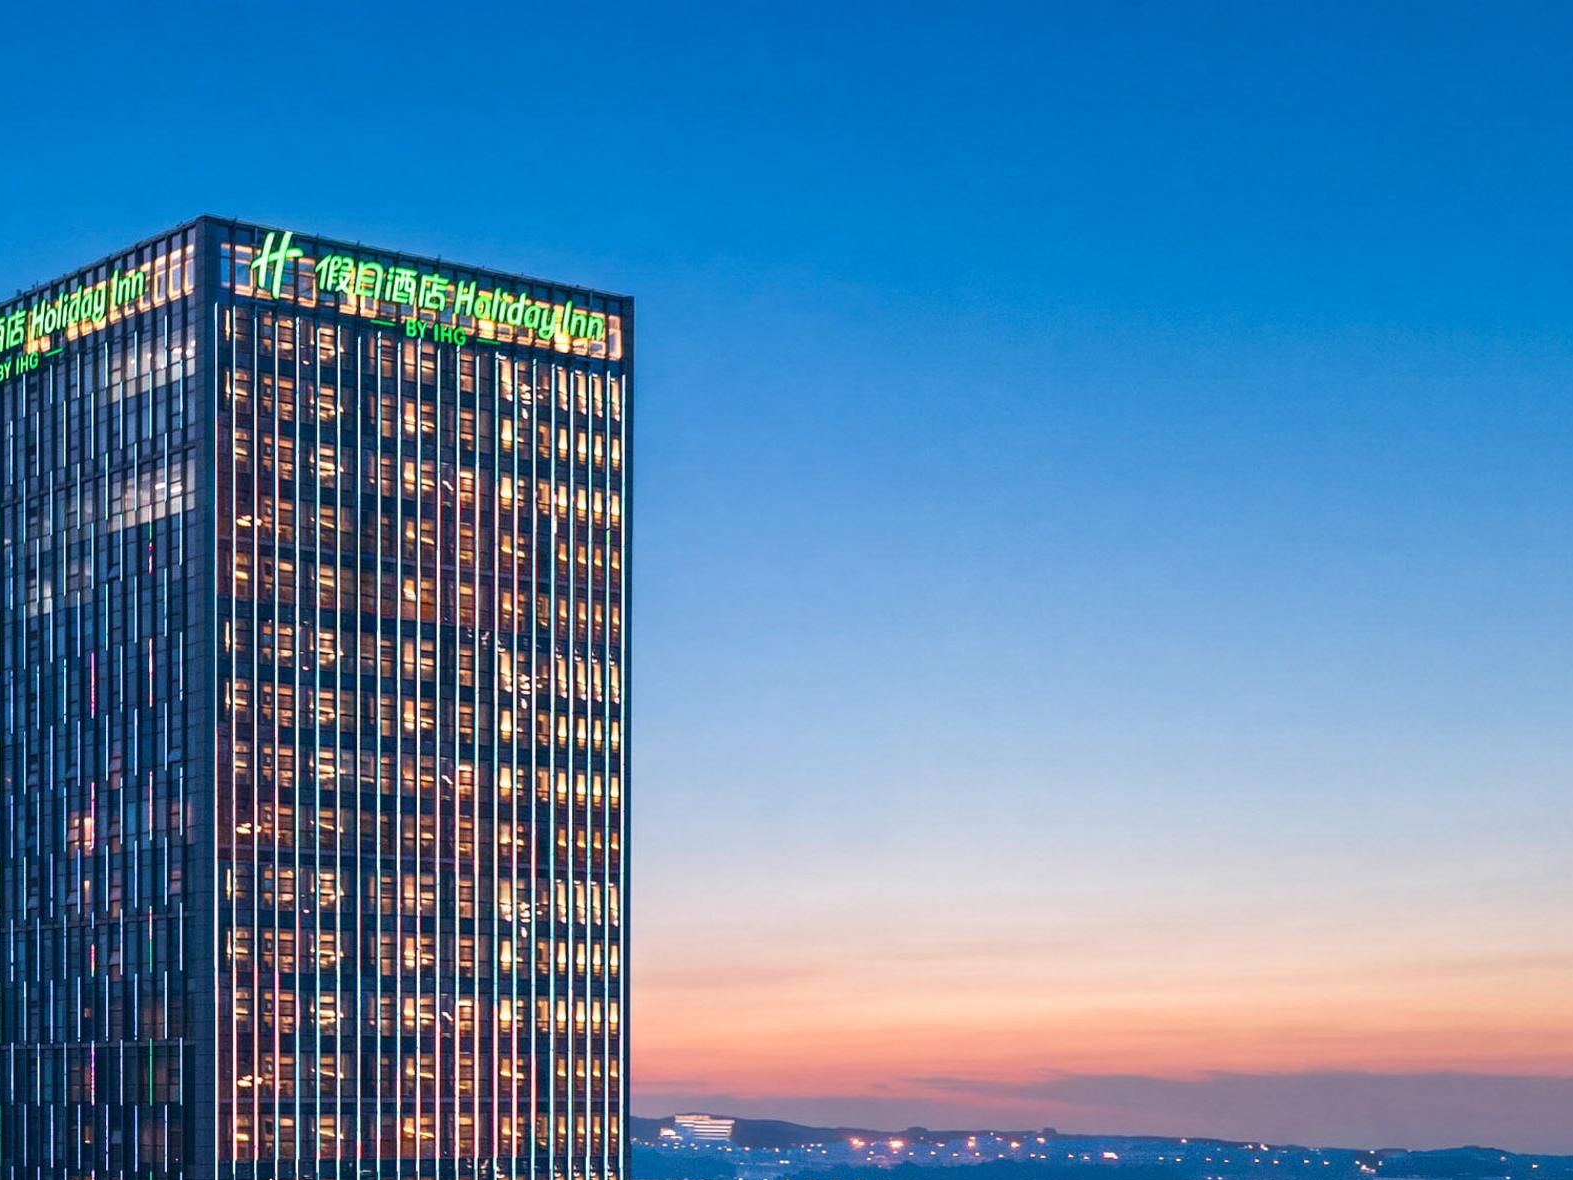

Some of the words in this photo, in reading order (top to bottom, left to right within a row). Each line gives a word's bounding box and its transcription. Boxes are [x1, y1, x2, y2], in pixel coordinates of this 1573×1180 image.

[30, 284, 108, 339] Holiday
[111, 269, 146, 306] Inn
[314, 253, 449, 312] 假日酒店
[453, 280, 557, 340] Holiday
[560, 300, 606, 341] Inn
[405, 320, 428, 339] BY
[433, 323, 467, 347] IHG
[15, 350, 40, 376] IHG
